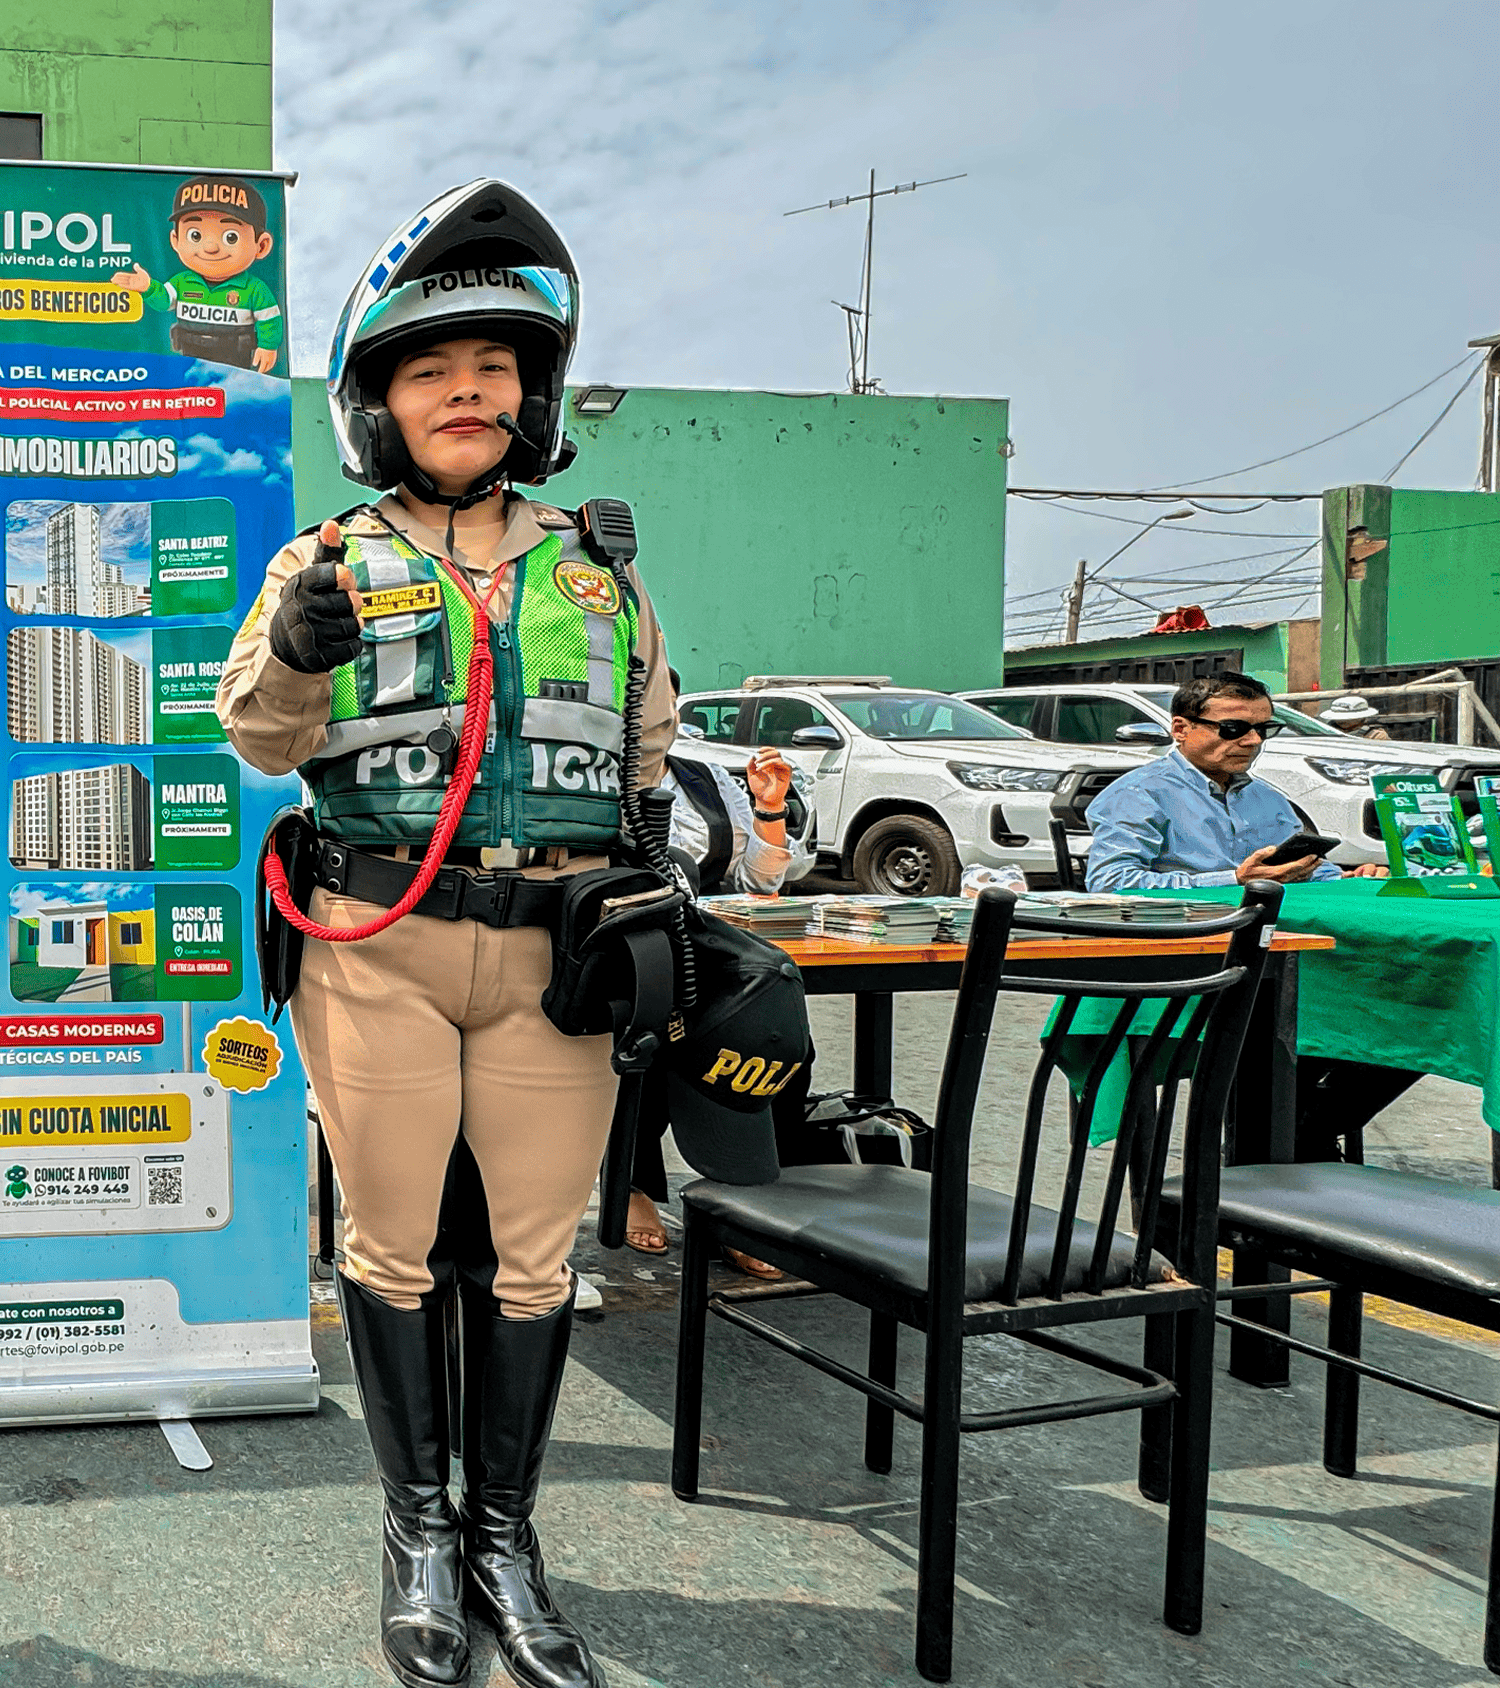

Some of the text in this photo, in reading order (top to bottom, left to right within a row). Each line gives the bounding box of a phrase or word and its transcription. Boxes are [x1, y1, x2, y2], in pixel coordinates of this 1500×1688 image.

[180, 183, 249, 210] POLICIA
[58, 253, 78, 267] de
[81, 255, 95, 268] la
[99, 256, 132, 268] PNP
[420, 267, 528, 300] POLICIA
[31, 289, 130, 314] BENEFICIOS
[181, 304, 239, 323] POLICIA
[10, 366, 47, 380] DEL
[51, 366, 148, 382] MERCADO
[9, 397, 71, 411] POLICIAL
[74, 400, 127, 412] ACTIVO
[130, 399, 139, 410] Y
[142, 399, 162, 409] EN
[165, 396, 217, 409] RETIRO
[158, 535, 229, 552] SANTA BEATRIZ
[162, 568, 225, 579] PRÓXIMAMENTE
[159, 662, 196, 679] SANTA
[161, 783, 228, 805] MANTRA
[165, 825, 227, 833] PRÓXIMAMENTE
[171, 906, 223, 922] OASIS DE
[172, 918, 224, 943] COLÁN
[6, 1024, 60, 1039] CASAS
[63, 1023, 156, 1038] MODERNAS
[69, 1051, 101, 1064] DEL
[105, 1047, 142, 1064] PAÍS
[218, 1037, 269, 1062] SORTEOS
[28, 1107, 94, 1134] CUOTA
[99, 1105, 172, 1133] INICIAL
[34, 1165, 131, 1183] CONOCE A FOVIBOT
[47, 1183, 129, 1196] 914 249 449
[21, 1309, 46, 1319] con
[49, 1306, 105, 1318] nosotros
[107, 1306, 116, 1315] a
[25, 1326, 33, 1341] /
[35, 1326, 61, 1342] (01)
[64, 1324, 126, 1338] 382-5581
